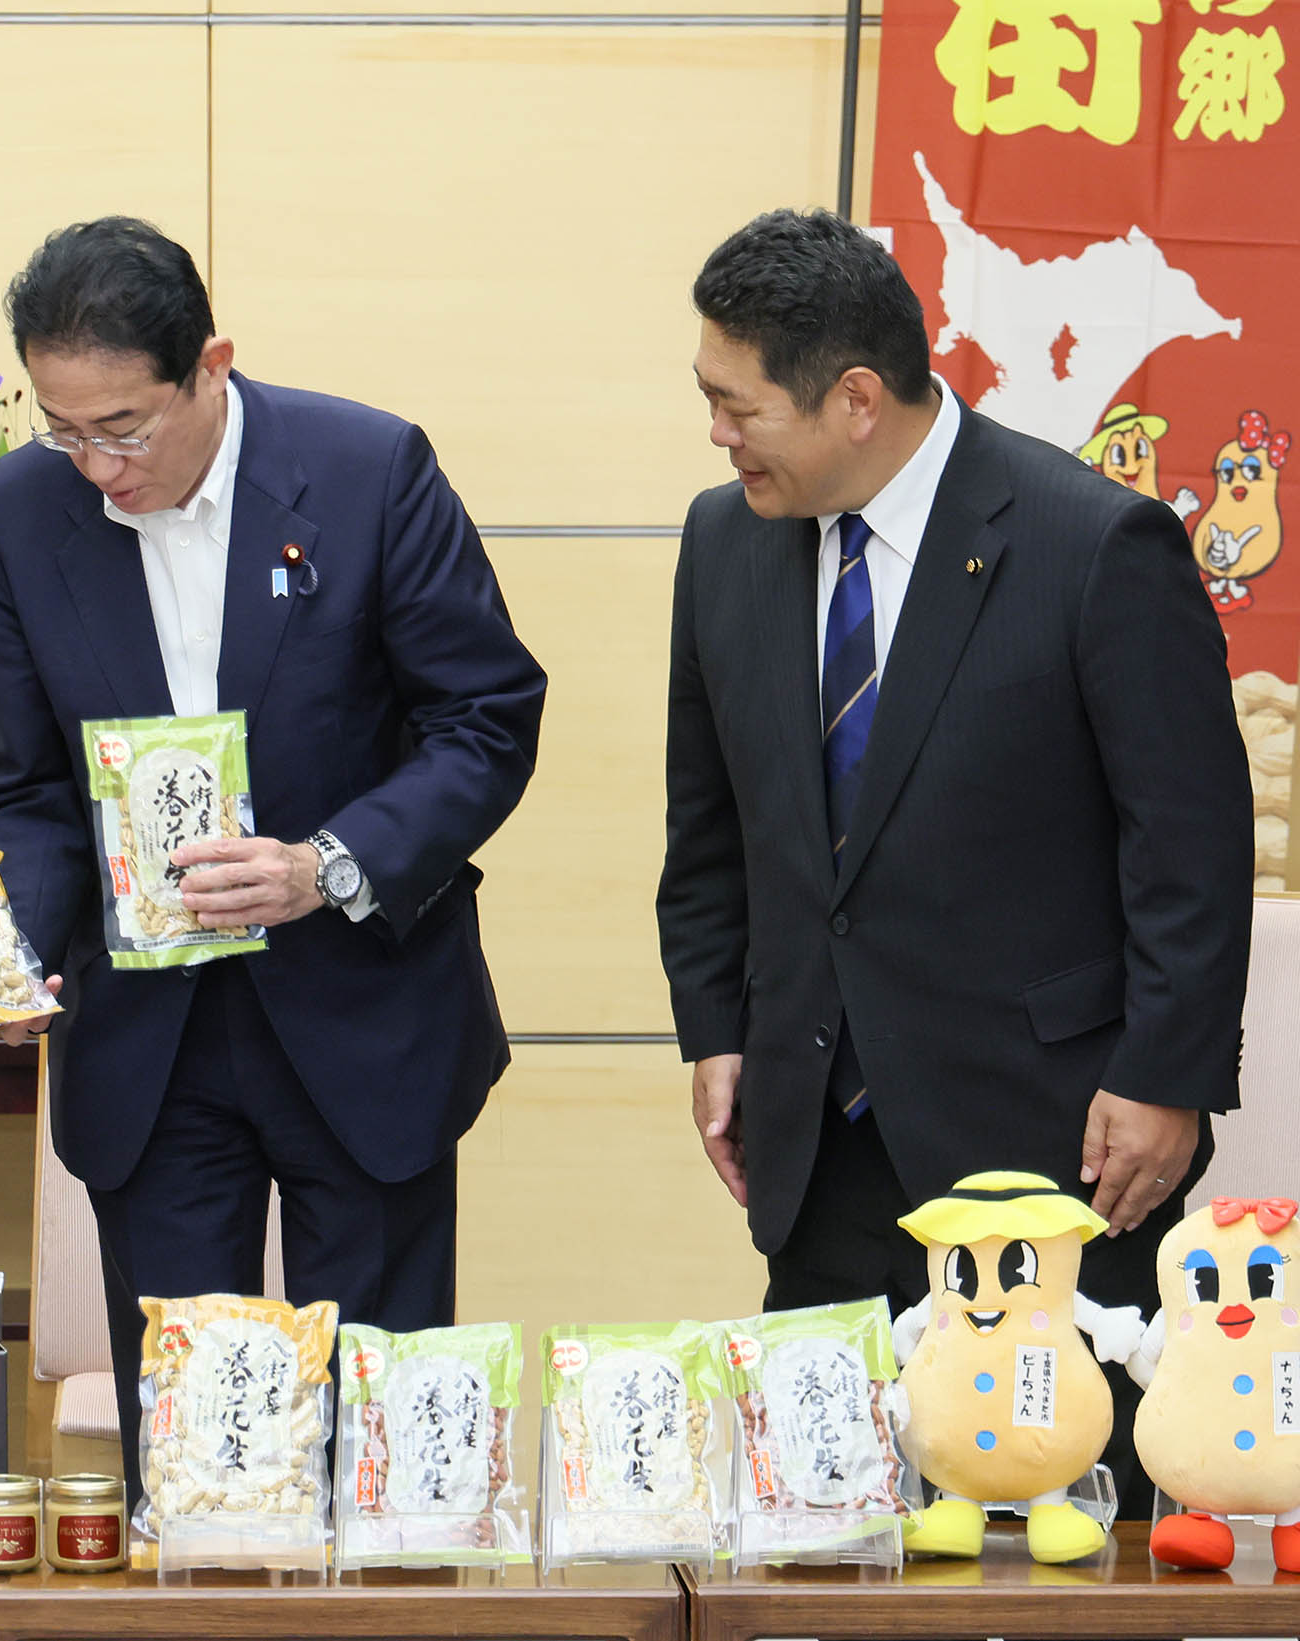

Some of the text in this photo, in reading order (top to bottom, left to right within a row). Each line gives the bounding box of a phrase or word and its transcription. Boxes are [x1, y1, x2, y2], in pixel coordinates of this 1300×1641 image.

[215, 1340, 258, 1472] 落花生
[453, 1372, 482, 1449] 八街産
[610, 1370, 654, 1493] 落花生
[652, 1365, 680, 1440] 八街産
[791, 1360, 845, 1481] 落花生
[829, 1352, 865, 1424] 八街産
[1280, 1360, 1294, 1424] ナッちゃん
[411, 1376, 452, 1503] 落花生
